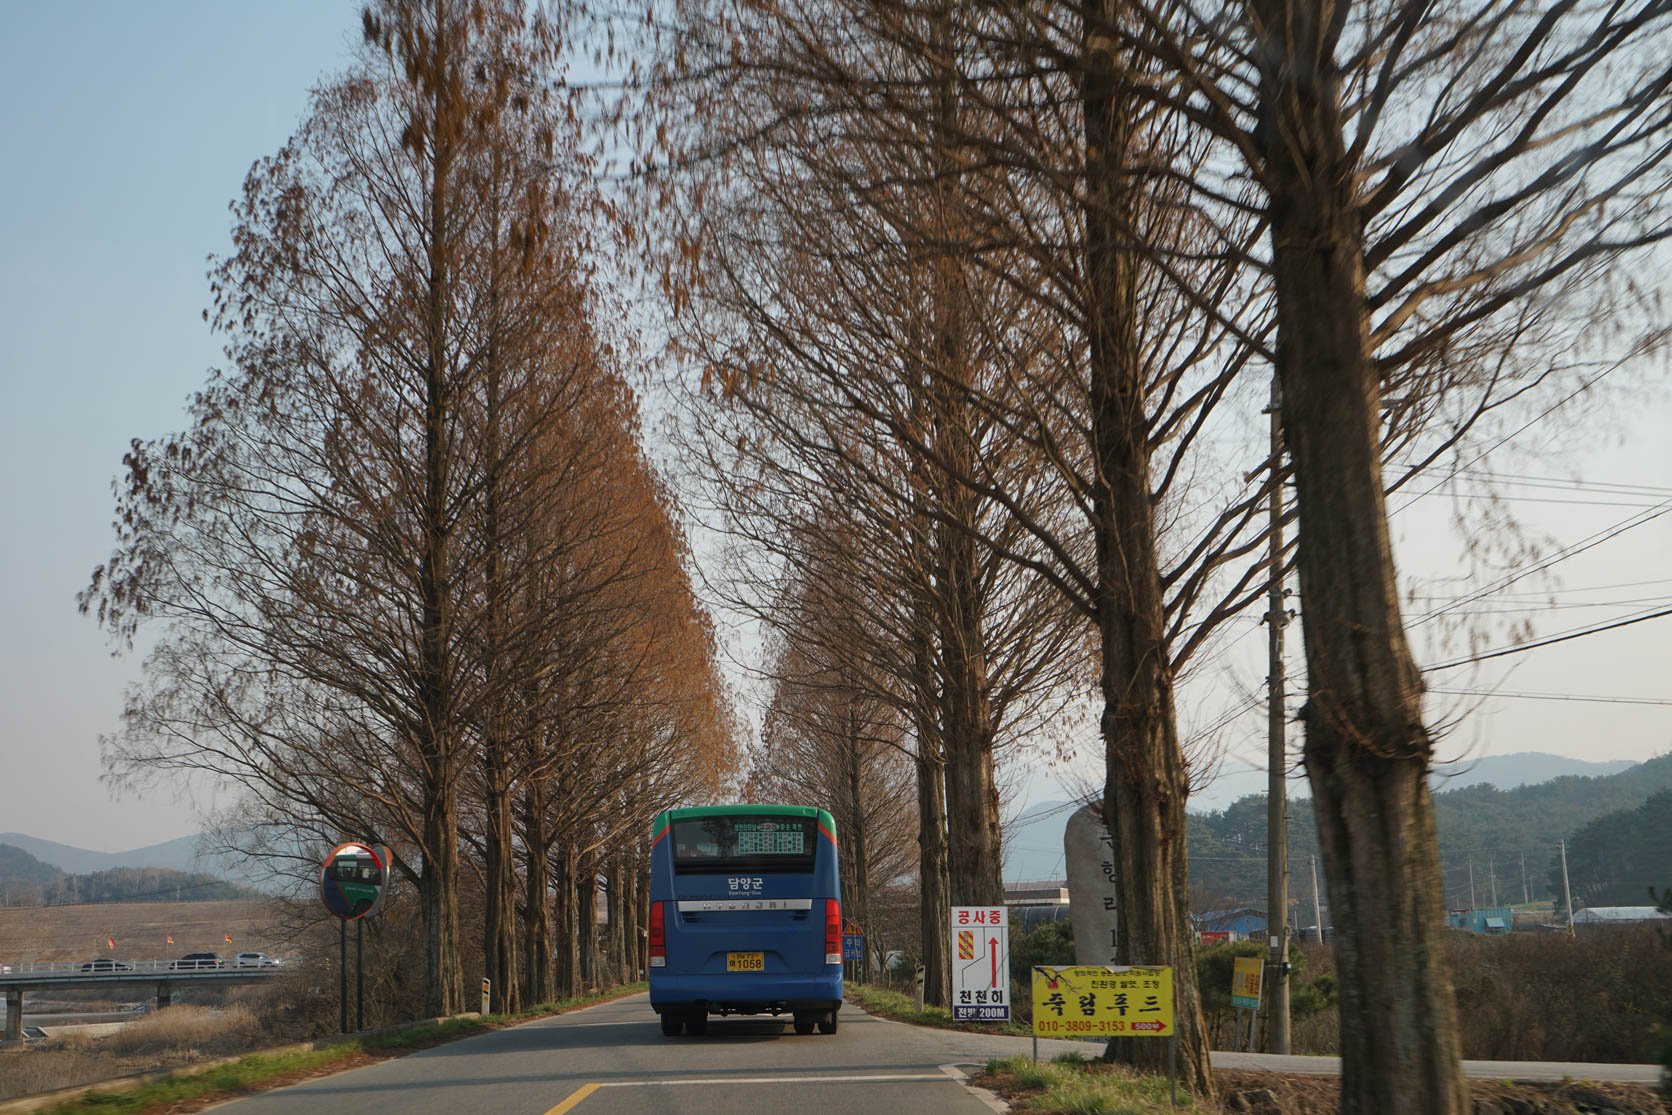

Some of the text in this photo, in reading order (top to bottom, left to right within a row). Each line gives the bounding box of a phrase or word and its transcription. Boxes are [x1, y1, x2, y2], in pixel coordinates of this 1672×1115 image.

[728, 877, 764, 890] 담양군
[958, 910, 1001, 925] 공사중
[737, 959, 762, 969] 1058
[1091, 980, 1117, 989] 친환경
[960, 990, 1003, 1004] 천천히
[979, 1007, 1005, 1018] 200M
[1038, 1020, 1125, 1032] 010-3809-3153
